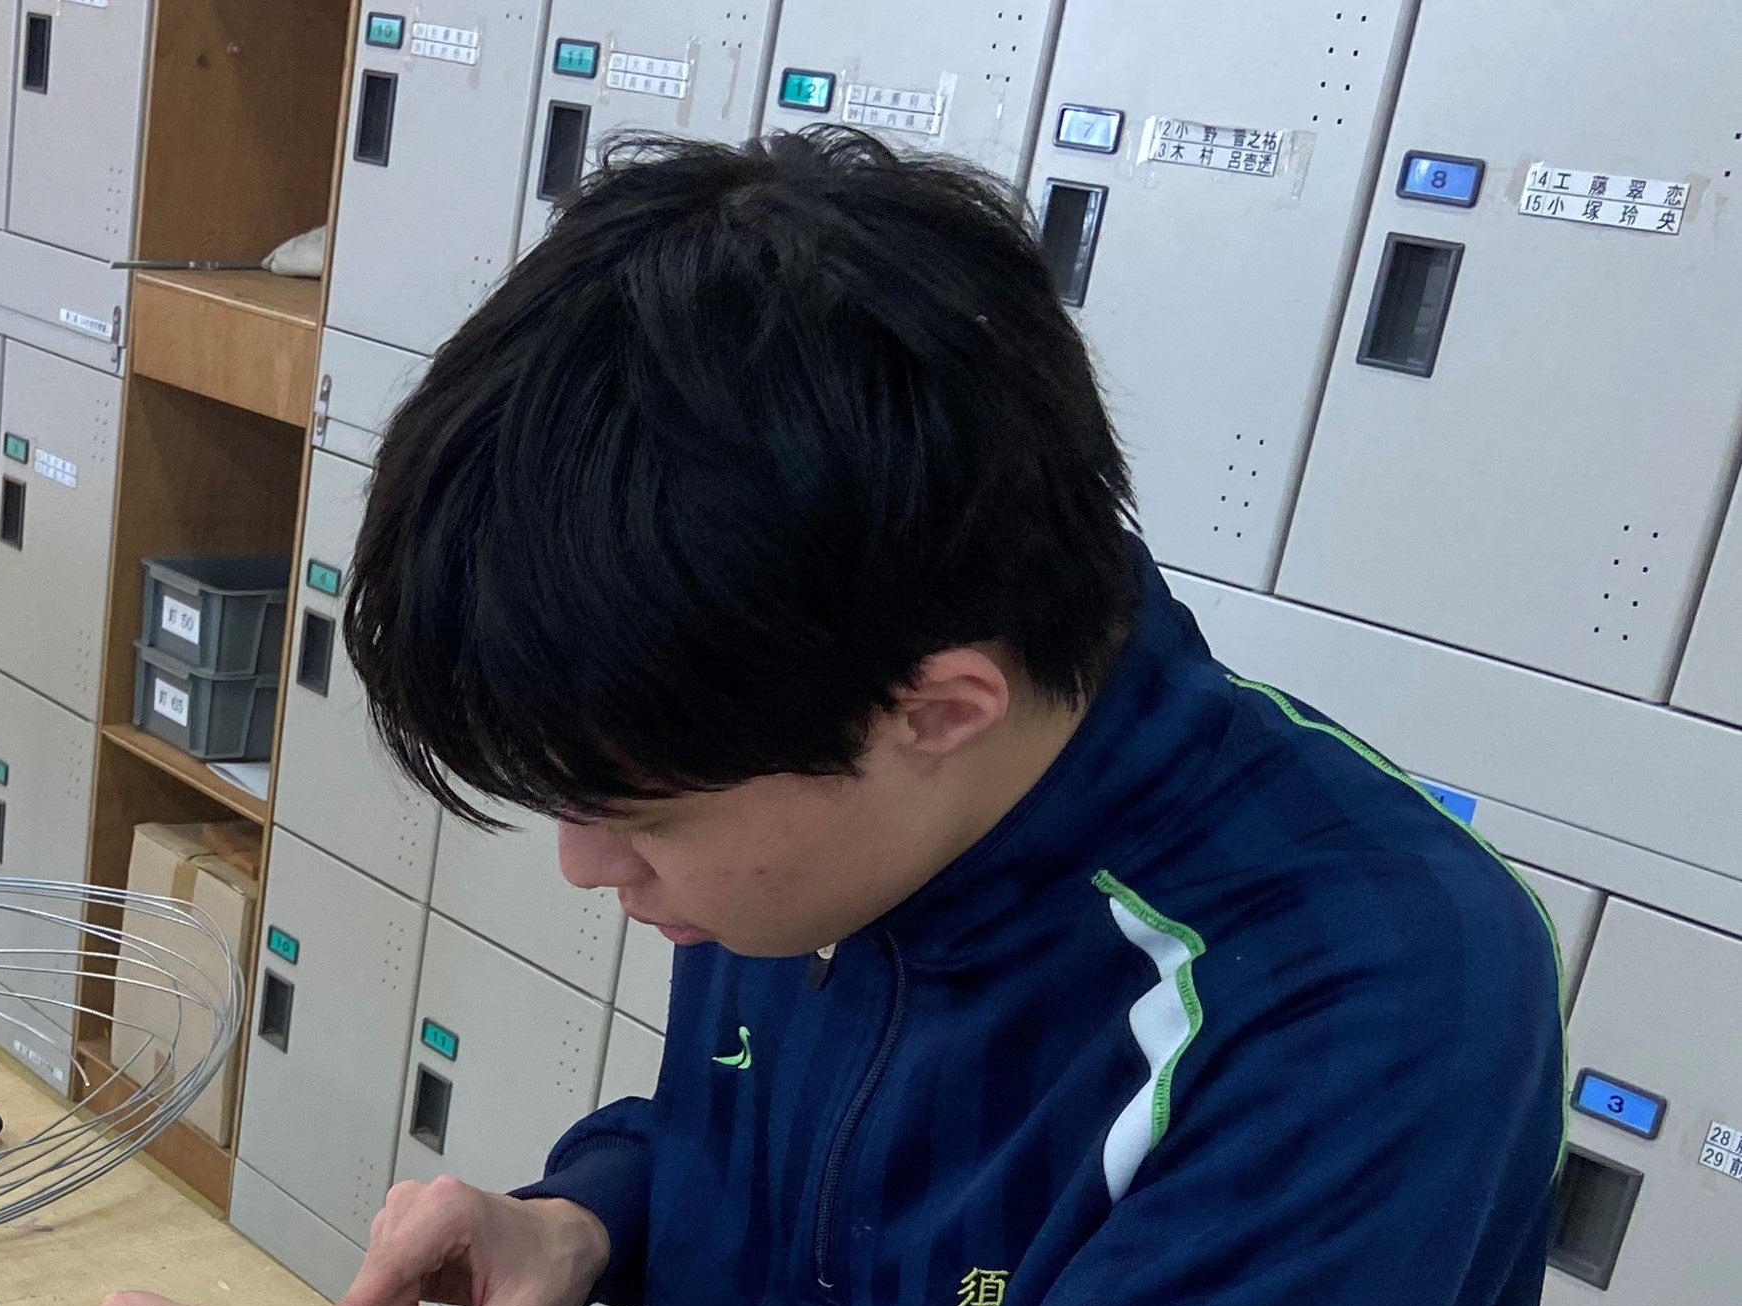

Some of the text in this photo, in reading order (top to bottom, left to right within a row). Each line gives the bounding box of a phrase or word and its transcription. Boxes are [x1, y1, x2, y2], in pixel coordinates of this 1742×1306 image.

[796, 82, 817, 98] 12
[1083, 121, 1094, 138] 7
[1431, 170, 1447, 189] 8
[1531, 171, 1549, 188] 14
[1525, 195, 1541, 212] 15
[1607, 1095, 1624, 1114] 3
[1710, 1126, 1731, 1146] 28
[1703, 1148, 1724, 1167] 29
